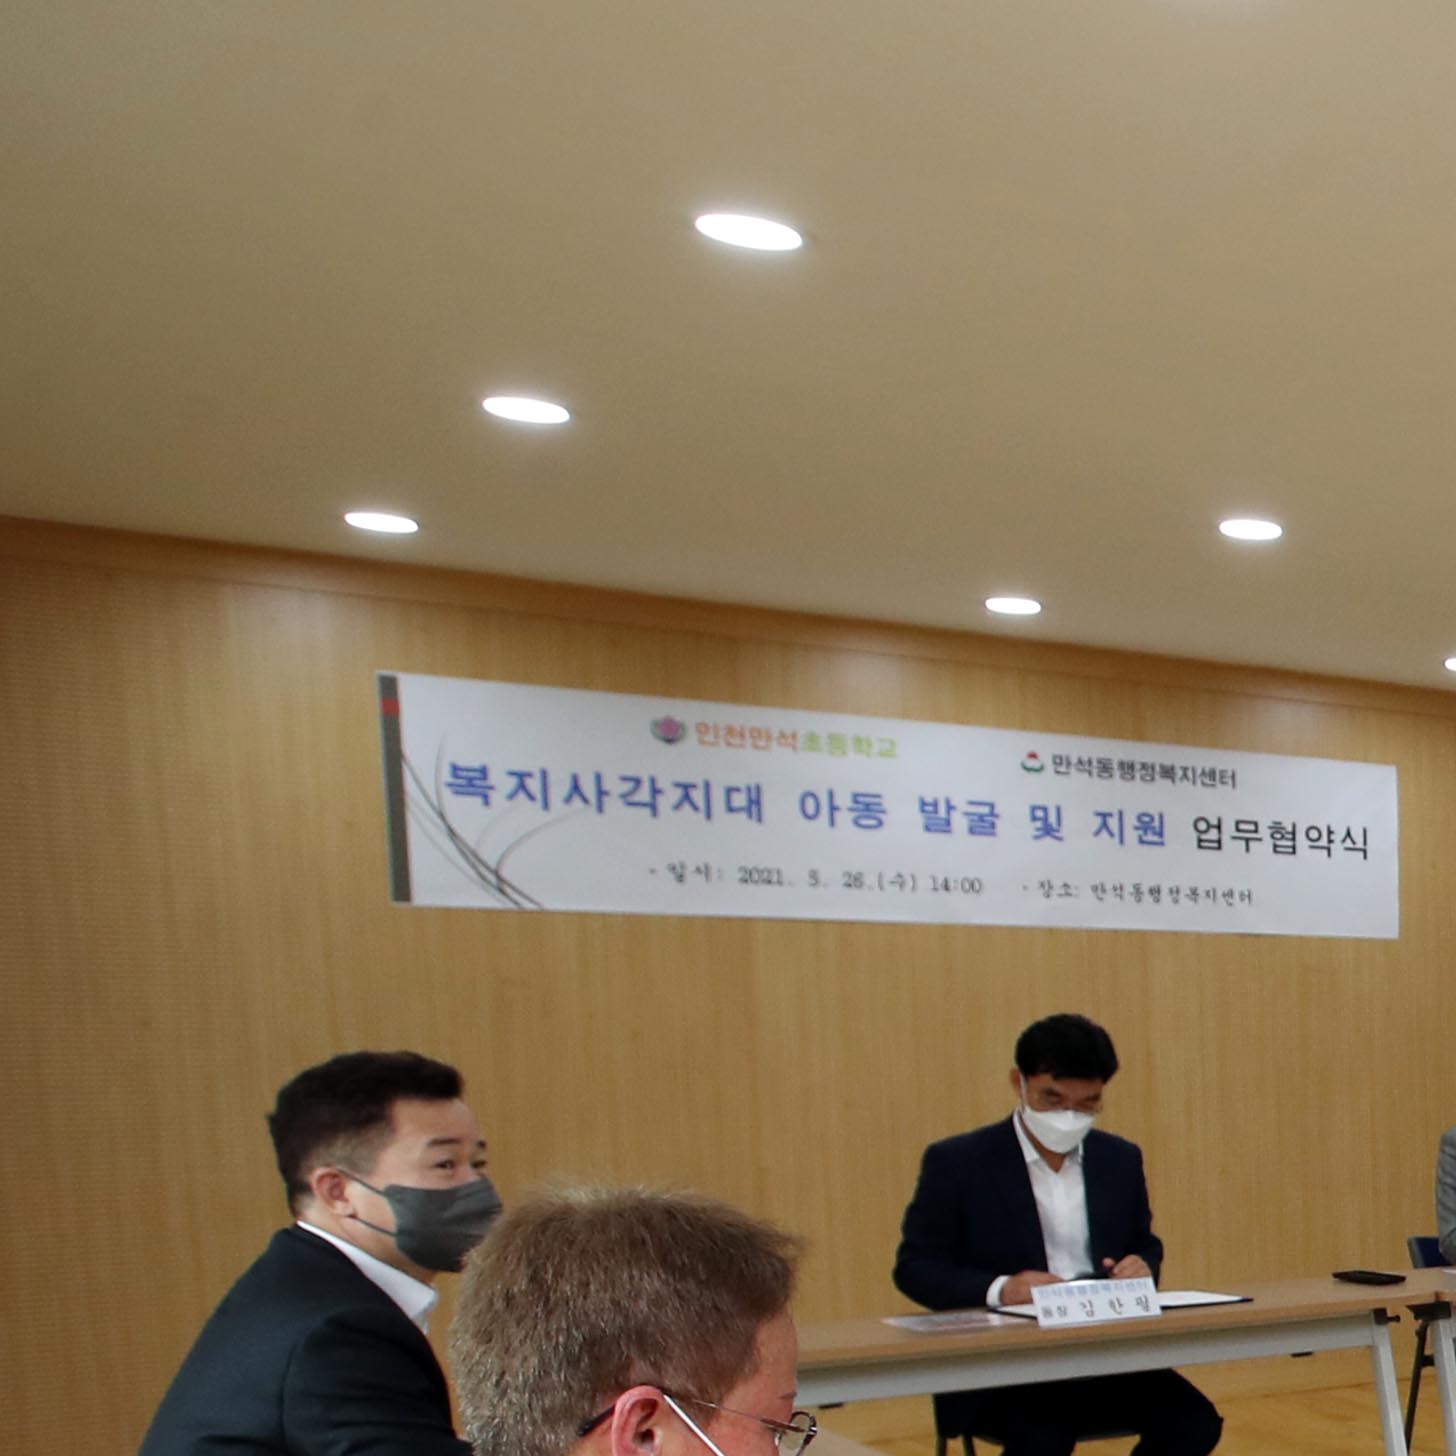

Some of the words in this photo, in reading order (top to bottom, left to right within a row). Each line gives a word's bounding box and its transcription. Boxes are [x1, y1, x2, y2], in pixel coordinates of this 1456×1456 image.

[695, 720, 897, 760] 인천만석초등학교
[1051, 753, 1237, 789] 만석동행정복지센터
[444, 761, 765, 824] 복지사각지대
[800, 787, 887, 831] 아동
[917, 796, 1000, 838] 발굴
[1030, 804, 1063, 841] 및
[1092, 809, 1166, 847] 지원
[1192, 814, 1369, 859] 업무협약식
[930, 874, 983, 895] 14:00
[1091, 881, 1253, 906] 만석동행정복지센터
